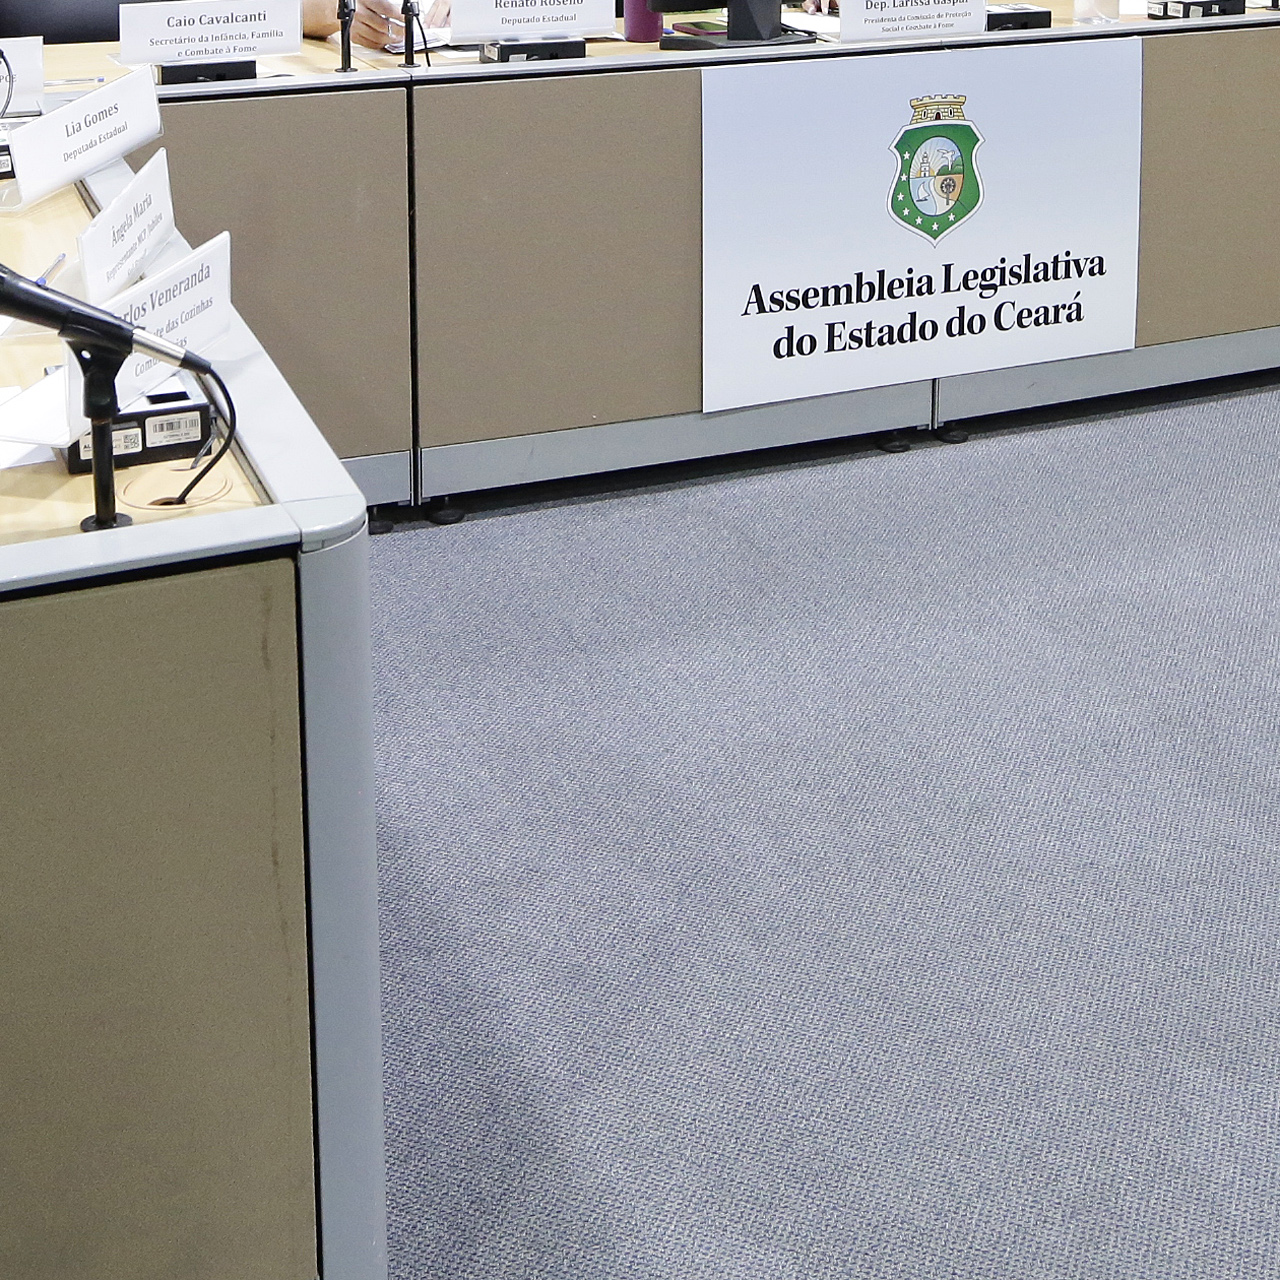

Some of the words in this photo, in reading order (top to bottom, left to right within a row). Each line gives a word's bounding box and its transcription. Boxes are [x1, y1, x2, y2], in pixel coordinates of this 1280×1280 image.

[167, 15, 195, 28] Caio
[198, 10, 267, 26] Cavalcanti
[501, 15, 540, 26] Deputado
[542, 13, 577, 23] Estadual
[865, 0, 890, 11] Dep.
[149, 34, 196, 46] Secretário
[198, 34, 209, 43] da
[251, 29, 284, 39] Família
[185, 46, 224, 57] Combate
[233, 44, 257, 53] Fome
[64, 121, 83, 138] Lia
[84, 102, 119, 128] Gomes
[63, 138, 97, 163] Deputada
[98, 121, 128, 144] Estadual
[149, 263, 211, 312] Veneranda
[740, 267, 936, 317] Assembleia
[941, 249, 1107, 304] Legislativa
[165, 317, 179, 333] das
[180, 296, 214, 324] Cozinhas
[772, 324, 817, 359] do
[823, 308, 939, 355] Estado
[945, 308, 986, 339] do
[992, 290, 1085, 332] Ceará
